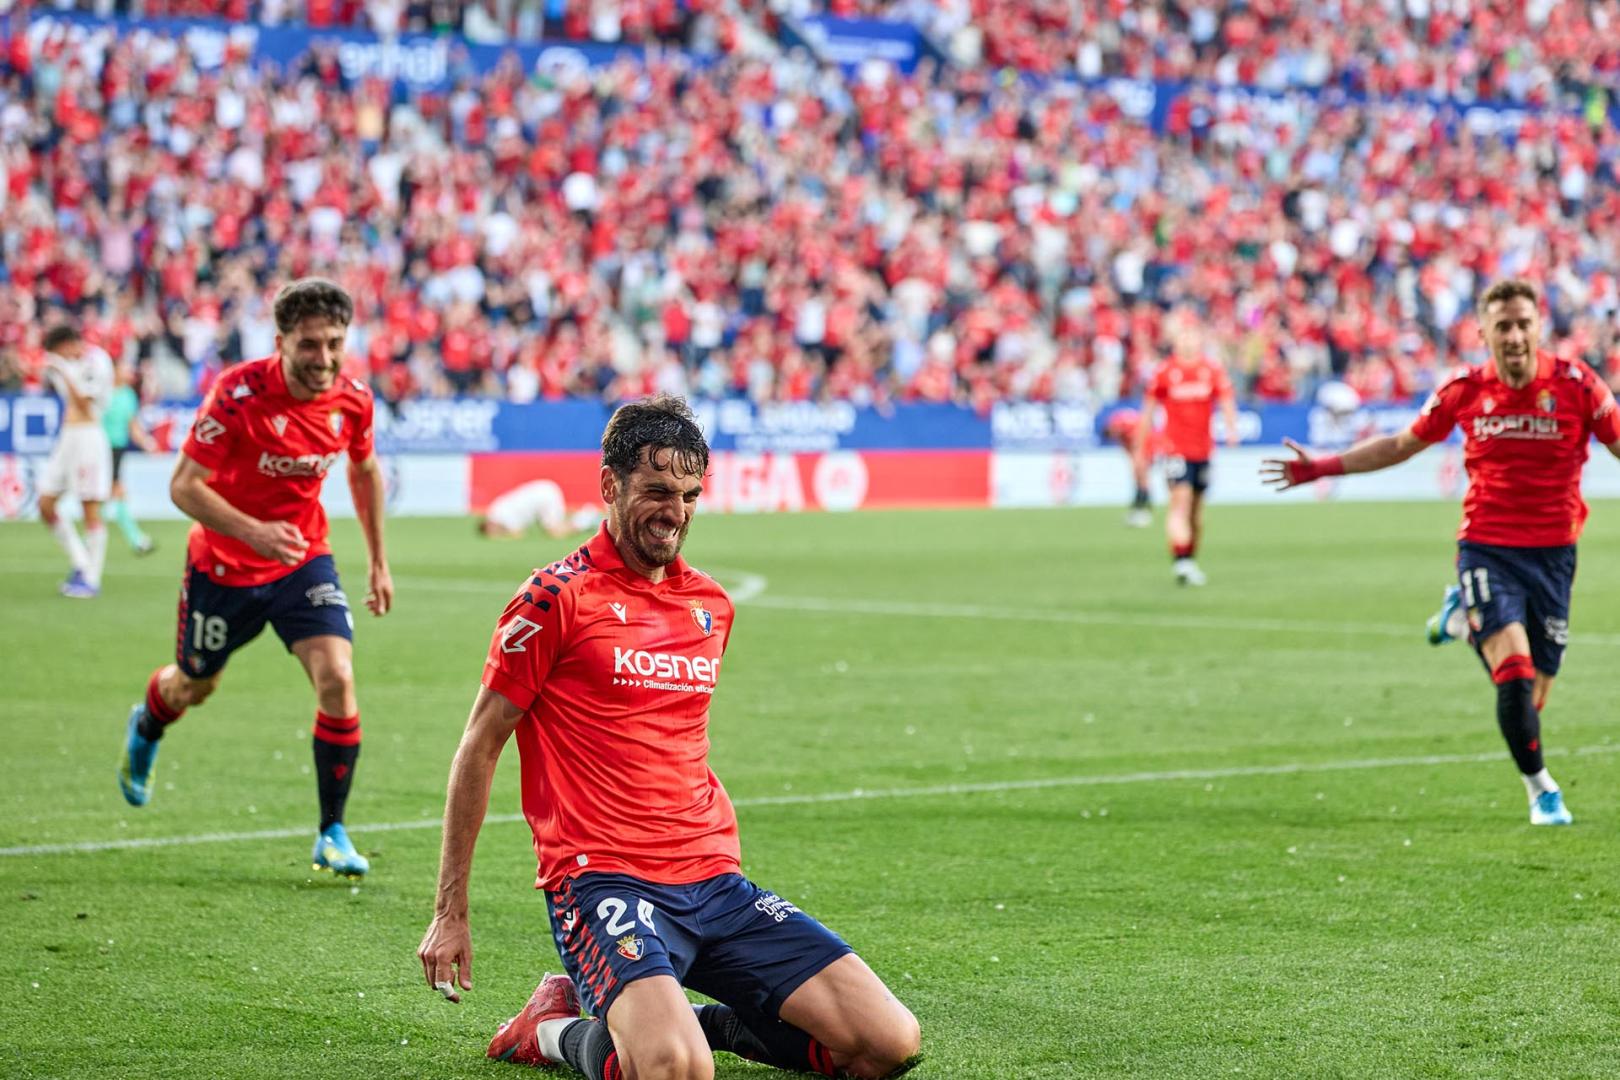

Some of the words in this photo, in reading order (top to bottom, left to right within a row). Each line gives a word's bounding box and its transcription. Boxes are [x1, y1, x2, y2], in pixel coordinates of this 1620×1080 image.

[1462, 568, 1491, 607] 11
[192, 610, 228, 650] 18
[614, 647, 719, 682] Kosner
[643, 680, 694, 692] Climatización
[774, 911, 788, 922] de
